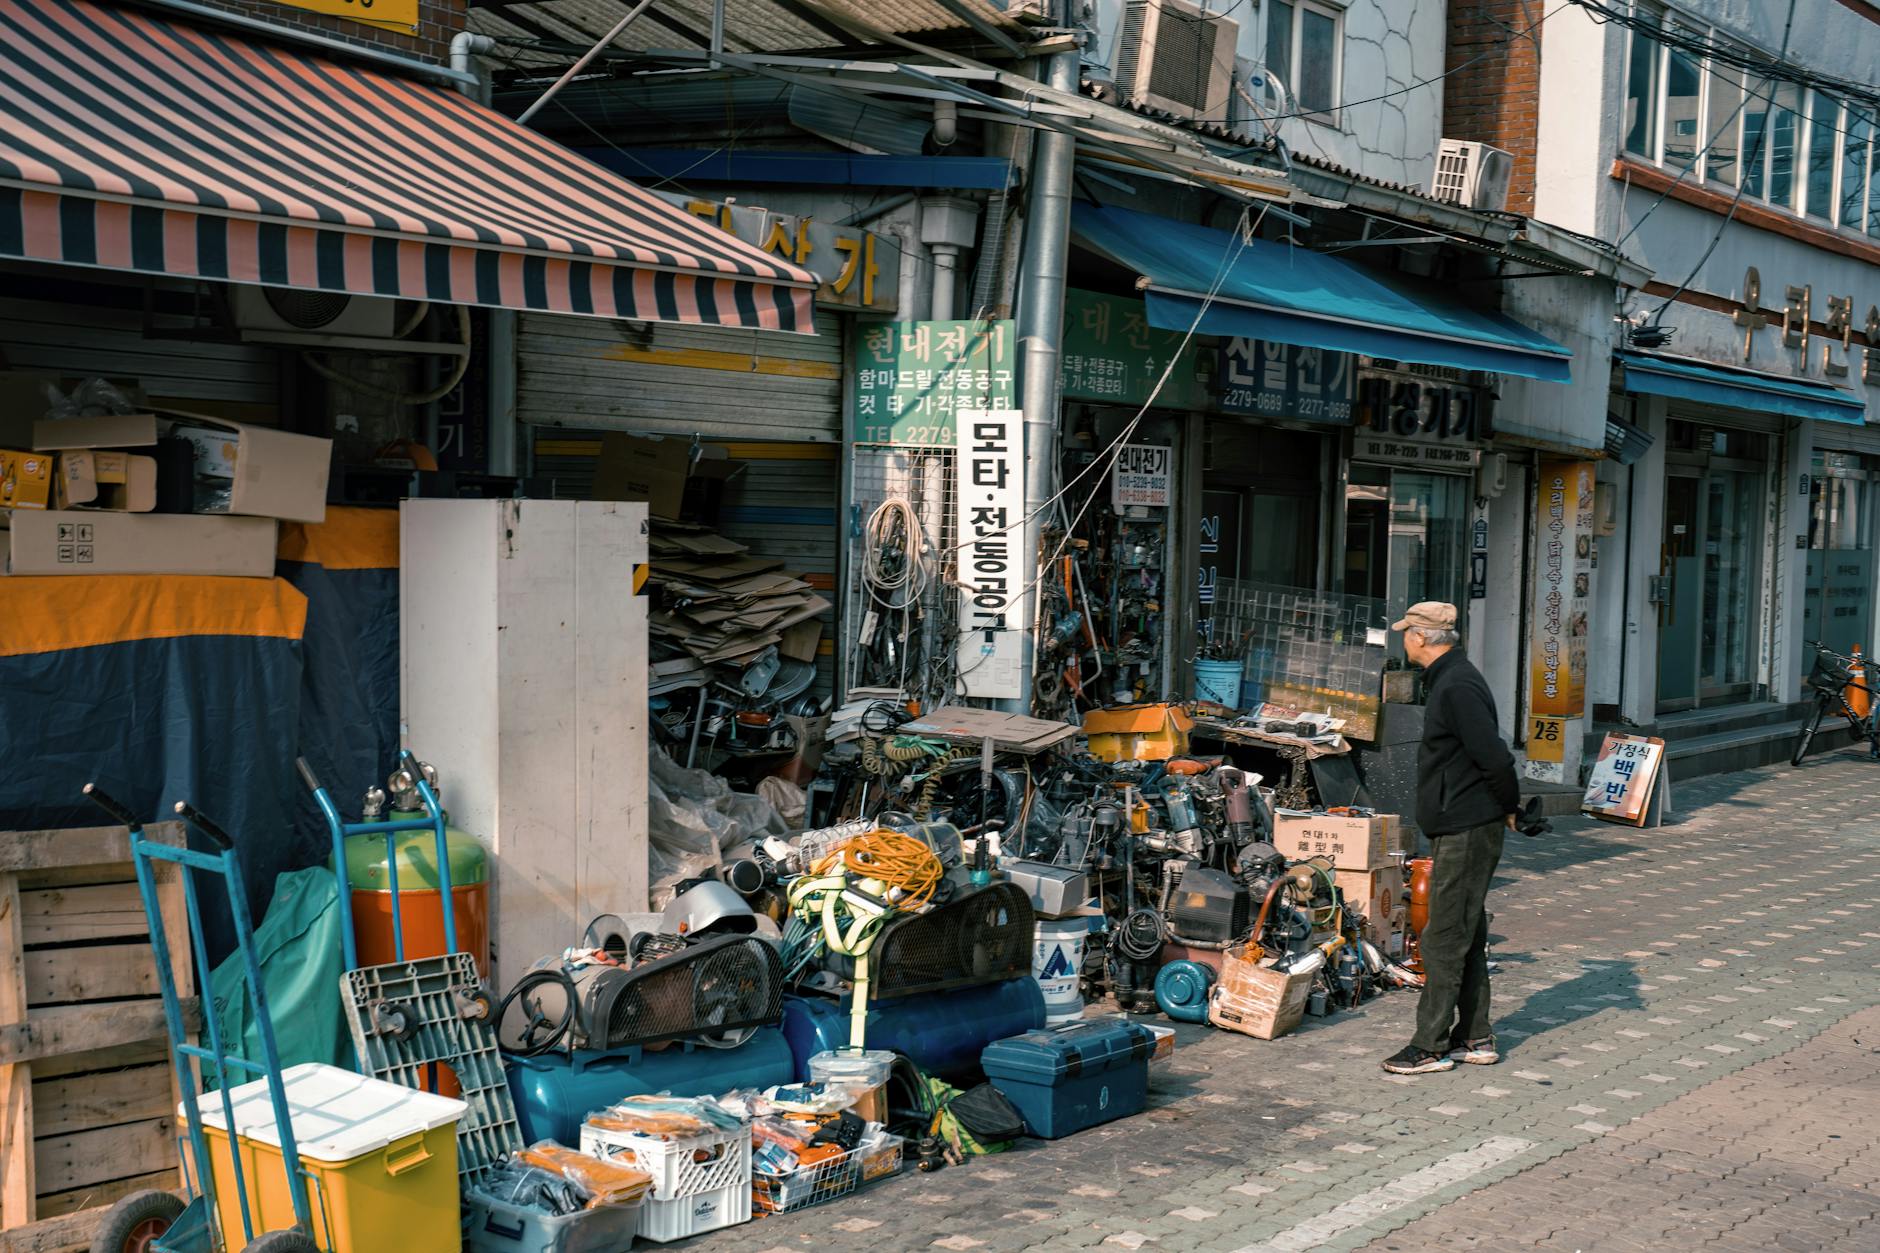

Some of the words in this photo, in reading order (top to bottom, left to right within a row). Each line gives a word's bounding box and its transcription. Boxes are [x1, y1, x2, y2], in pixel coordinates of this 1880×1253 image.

[864, 325, 1004, 363] 현대전기
[859, 395, 875, 414] 컷
[887, 395, 904, 415] 타
[865, 426, 899, 443] TEL
[1534, 720, 1560, 741] 2층
[1609, 741, 1651, 760] 가정식
